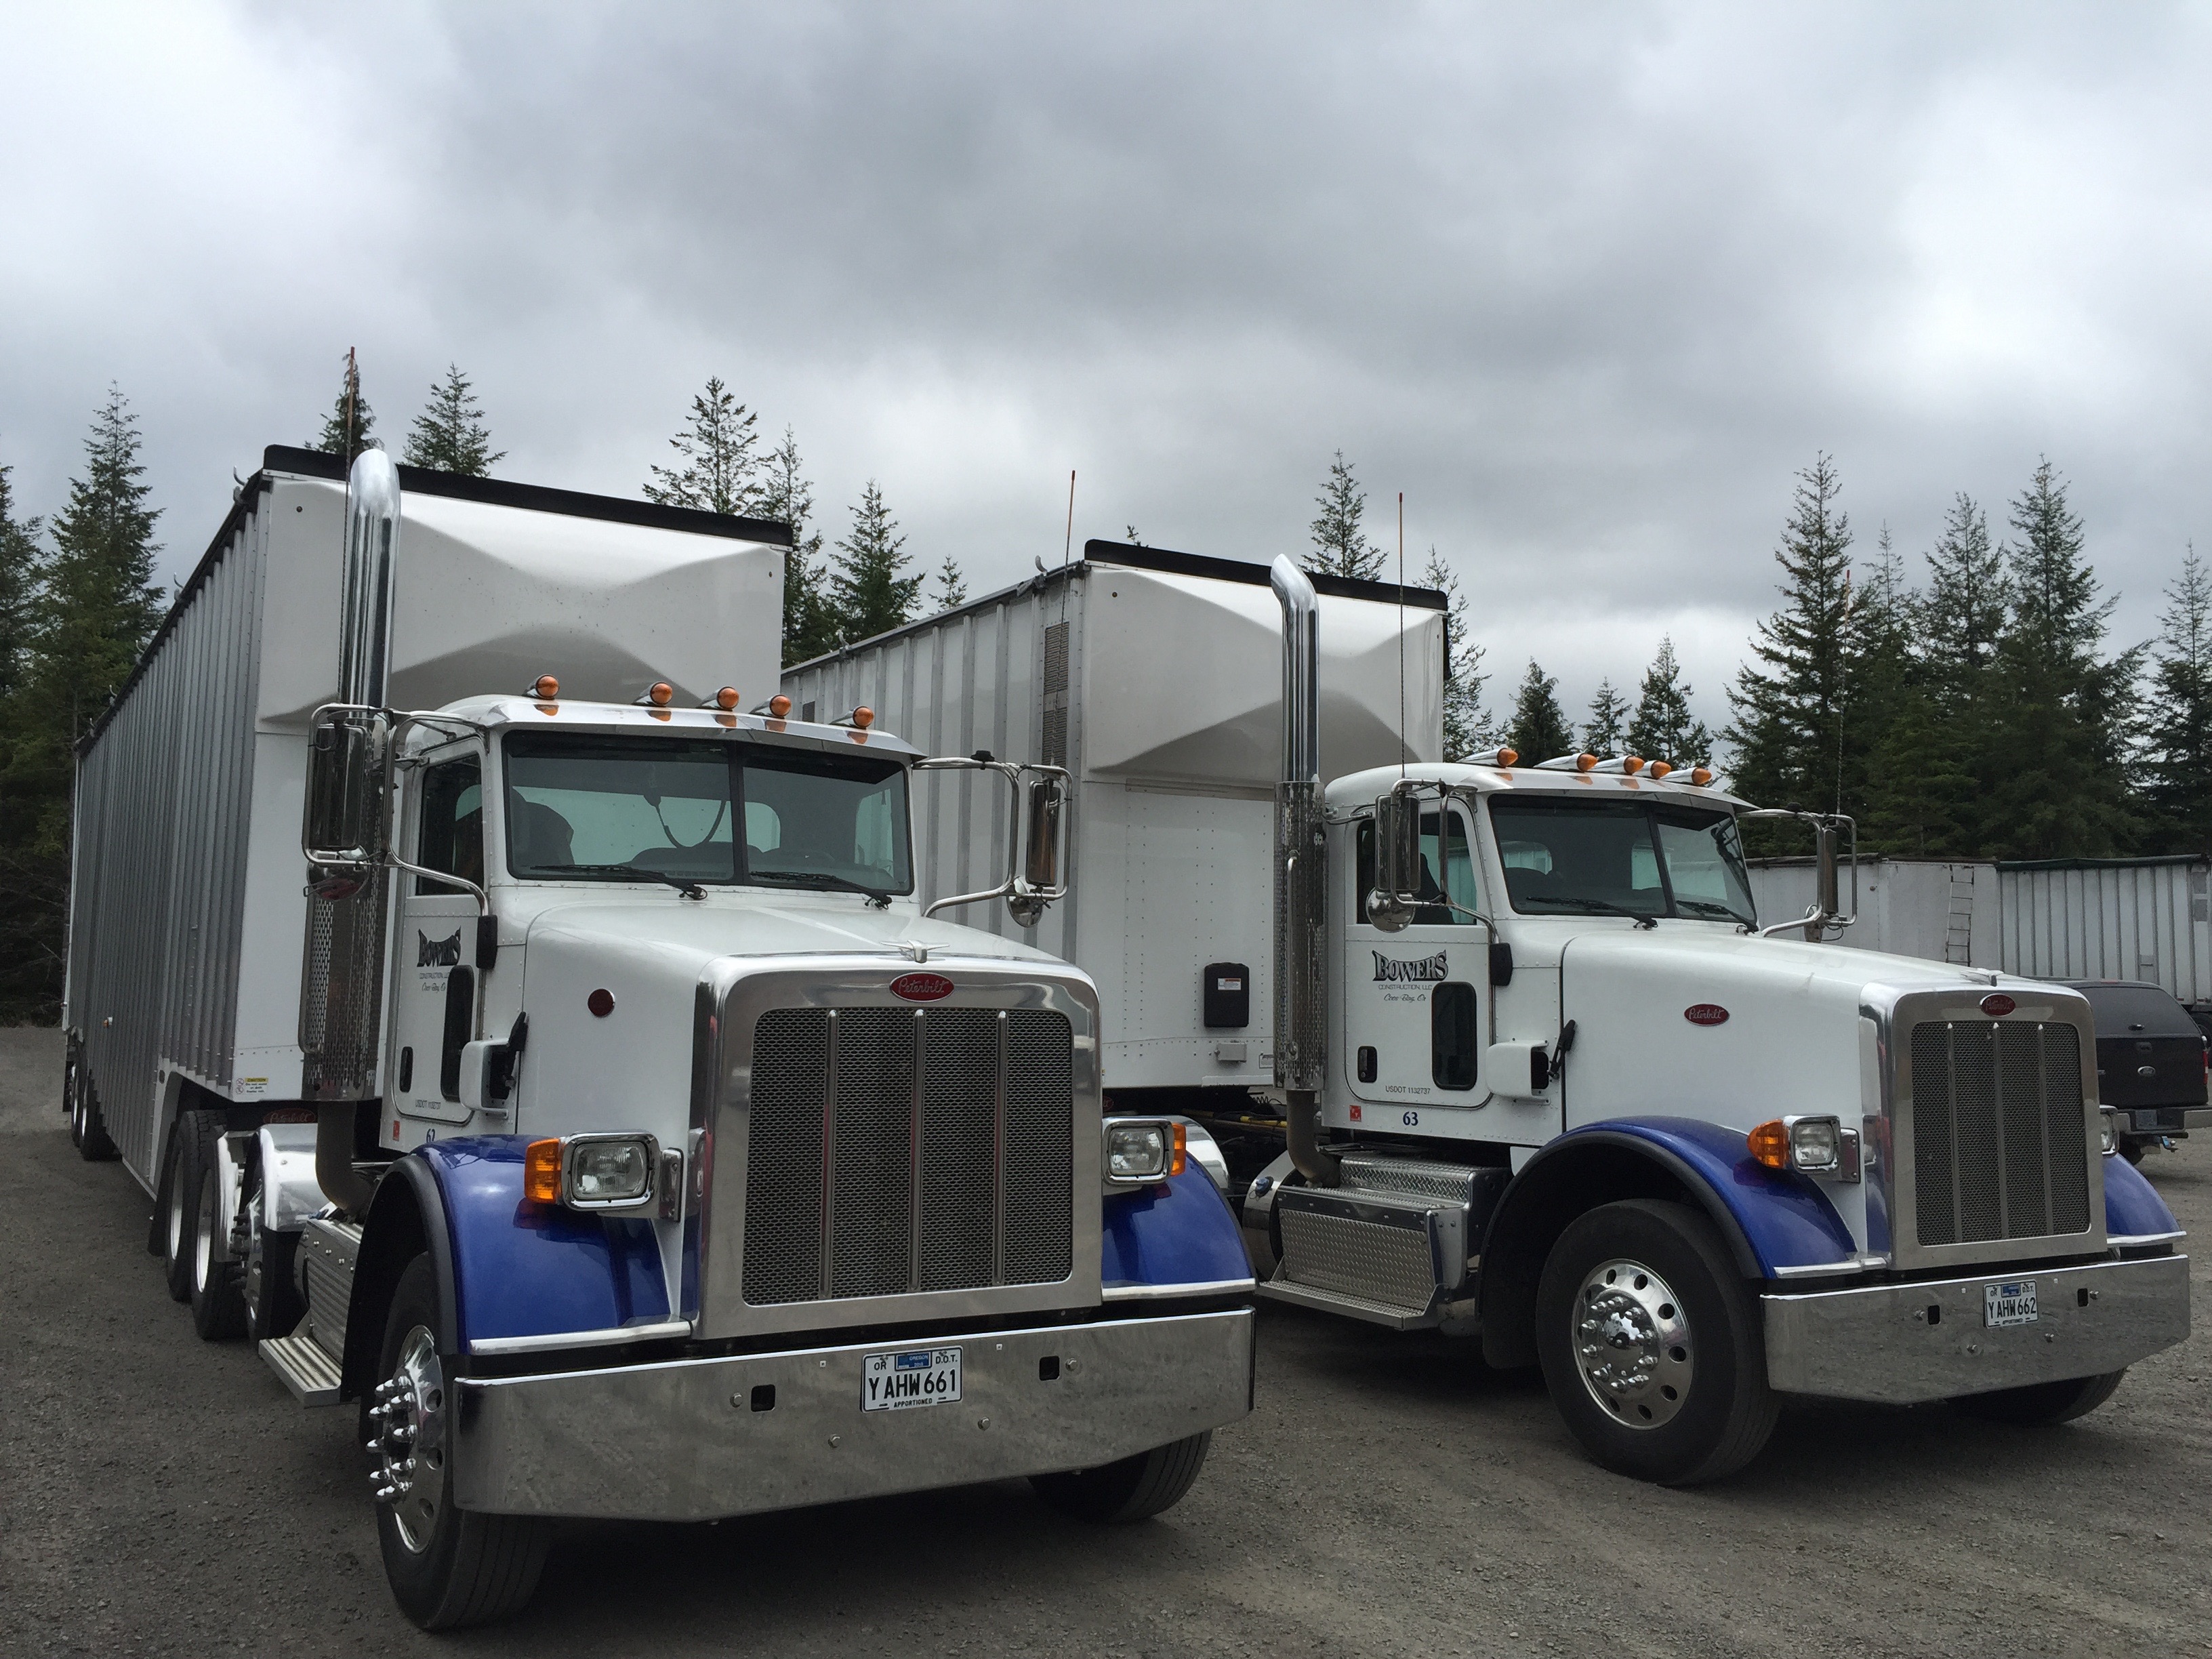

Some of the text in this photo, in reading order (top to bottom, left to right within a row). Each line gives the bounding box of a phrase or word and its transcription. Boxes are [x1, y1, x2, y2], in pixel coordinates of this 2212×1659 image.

[1372, 949, 1449, 982] BOWERS
[899, 977, 949, 994] Peterbilt
[1689, 1007, 1724, 1020] Peterbilt
[1385, 1085, 1406, 1093] USDOT
[1402, 1111, 1418, 1126] 63
[874, 1354, 958, 1371] OR D.O.T.
[894, 1398, 933, 1408] APPORTIONED
